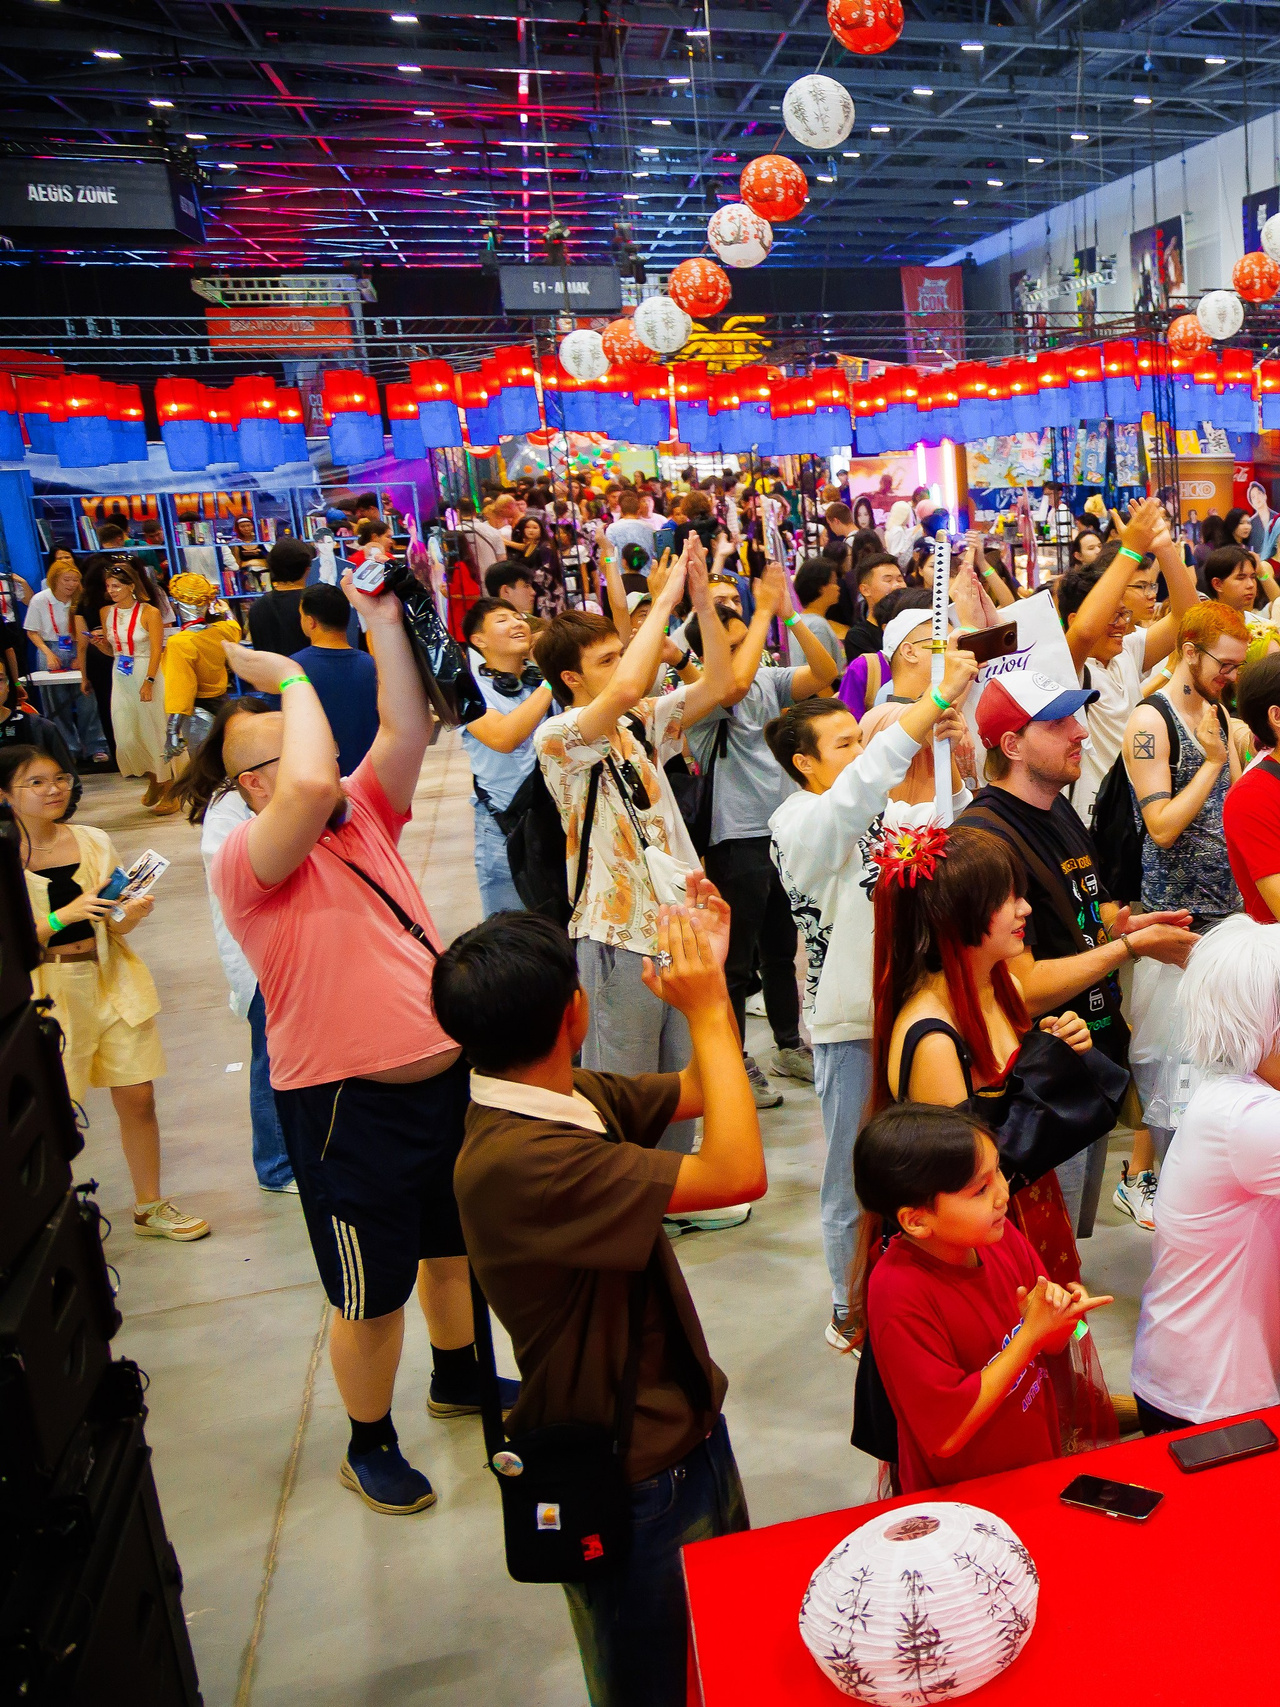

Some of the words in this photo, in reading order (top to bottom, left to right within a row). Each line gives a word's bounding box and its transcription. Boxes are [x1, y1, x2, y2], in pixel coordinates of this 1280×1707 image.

[27, 183, 74, 203] AEGIS
[77, 185, 119, 205] ZONE
[532, 281, 546, 294] 51
[80, 493, 159, 522] YOU
[174, 490, 253, 520] WIN!
